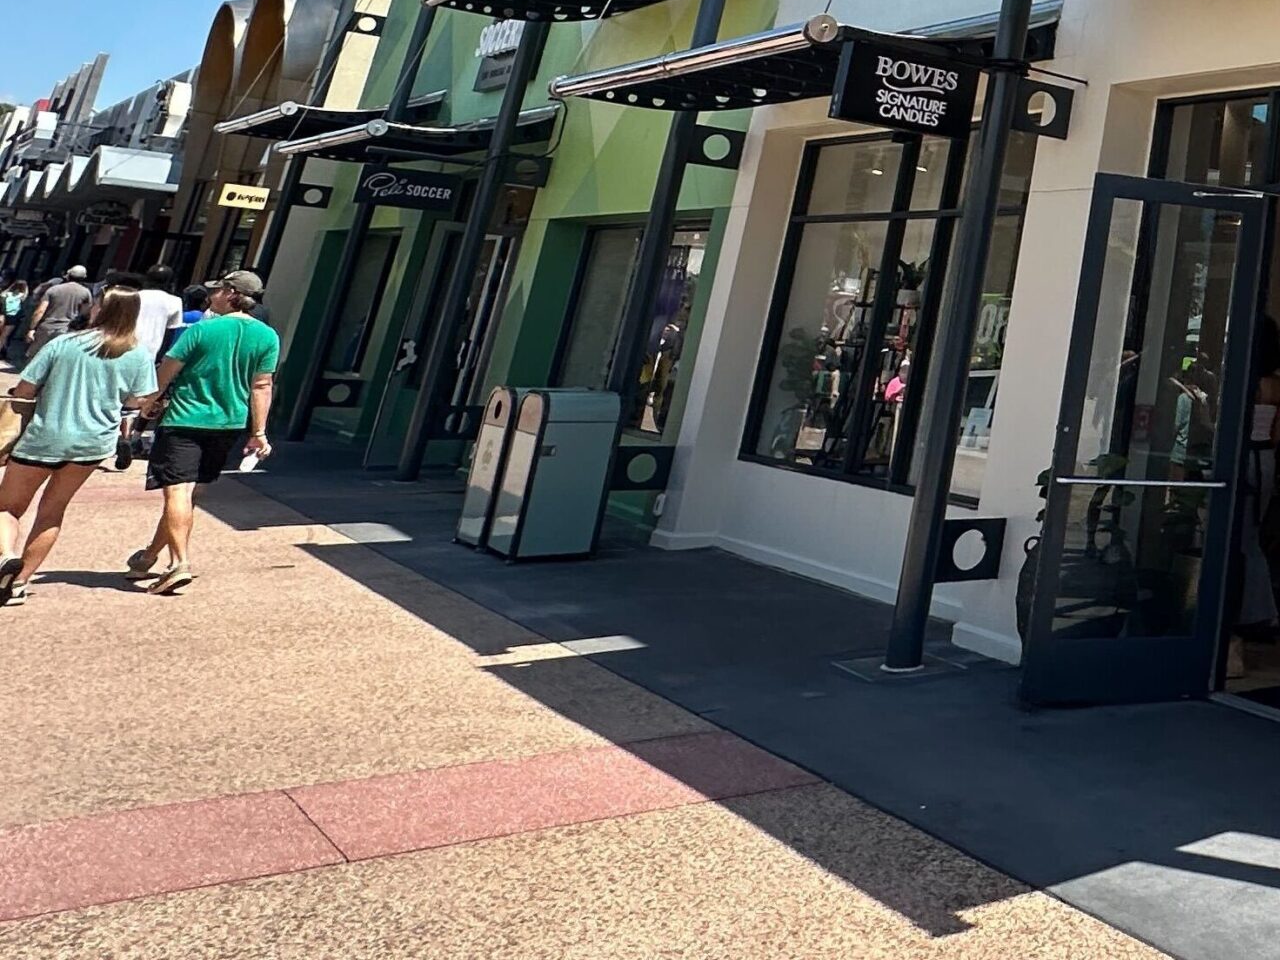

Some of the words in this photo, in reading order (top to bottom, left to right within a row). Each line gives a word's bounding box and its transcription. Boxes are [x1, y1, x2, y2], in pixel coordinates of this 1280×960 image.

[875, 56, 959, 91] BOWES
[876, 89, 947, 115] SIGNATURE
[879, 104, 939, 127] CANDLES
[405, 184, 452, 200] SOCCER
